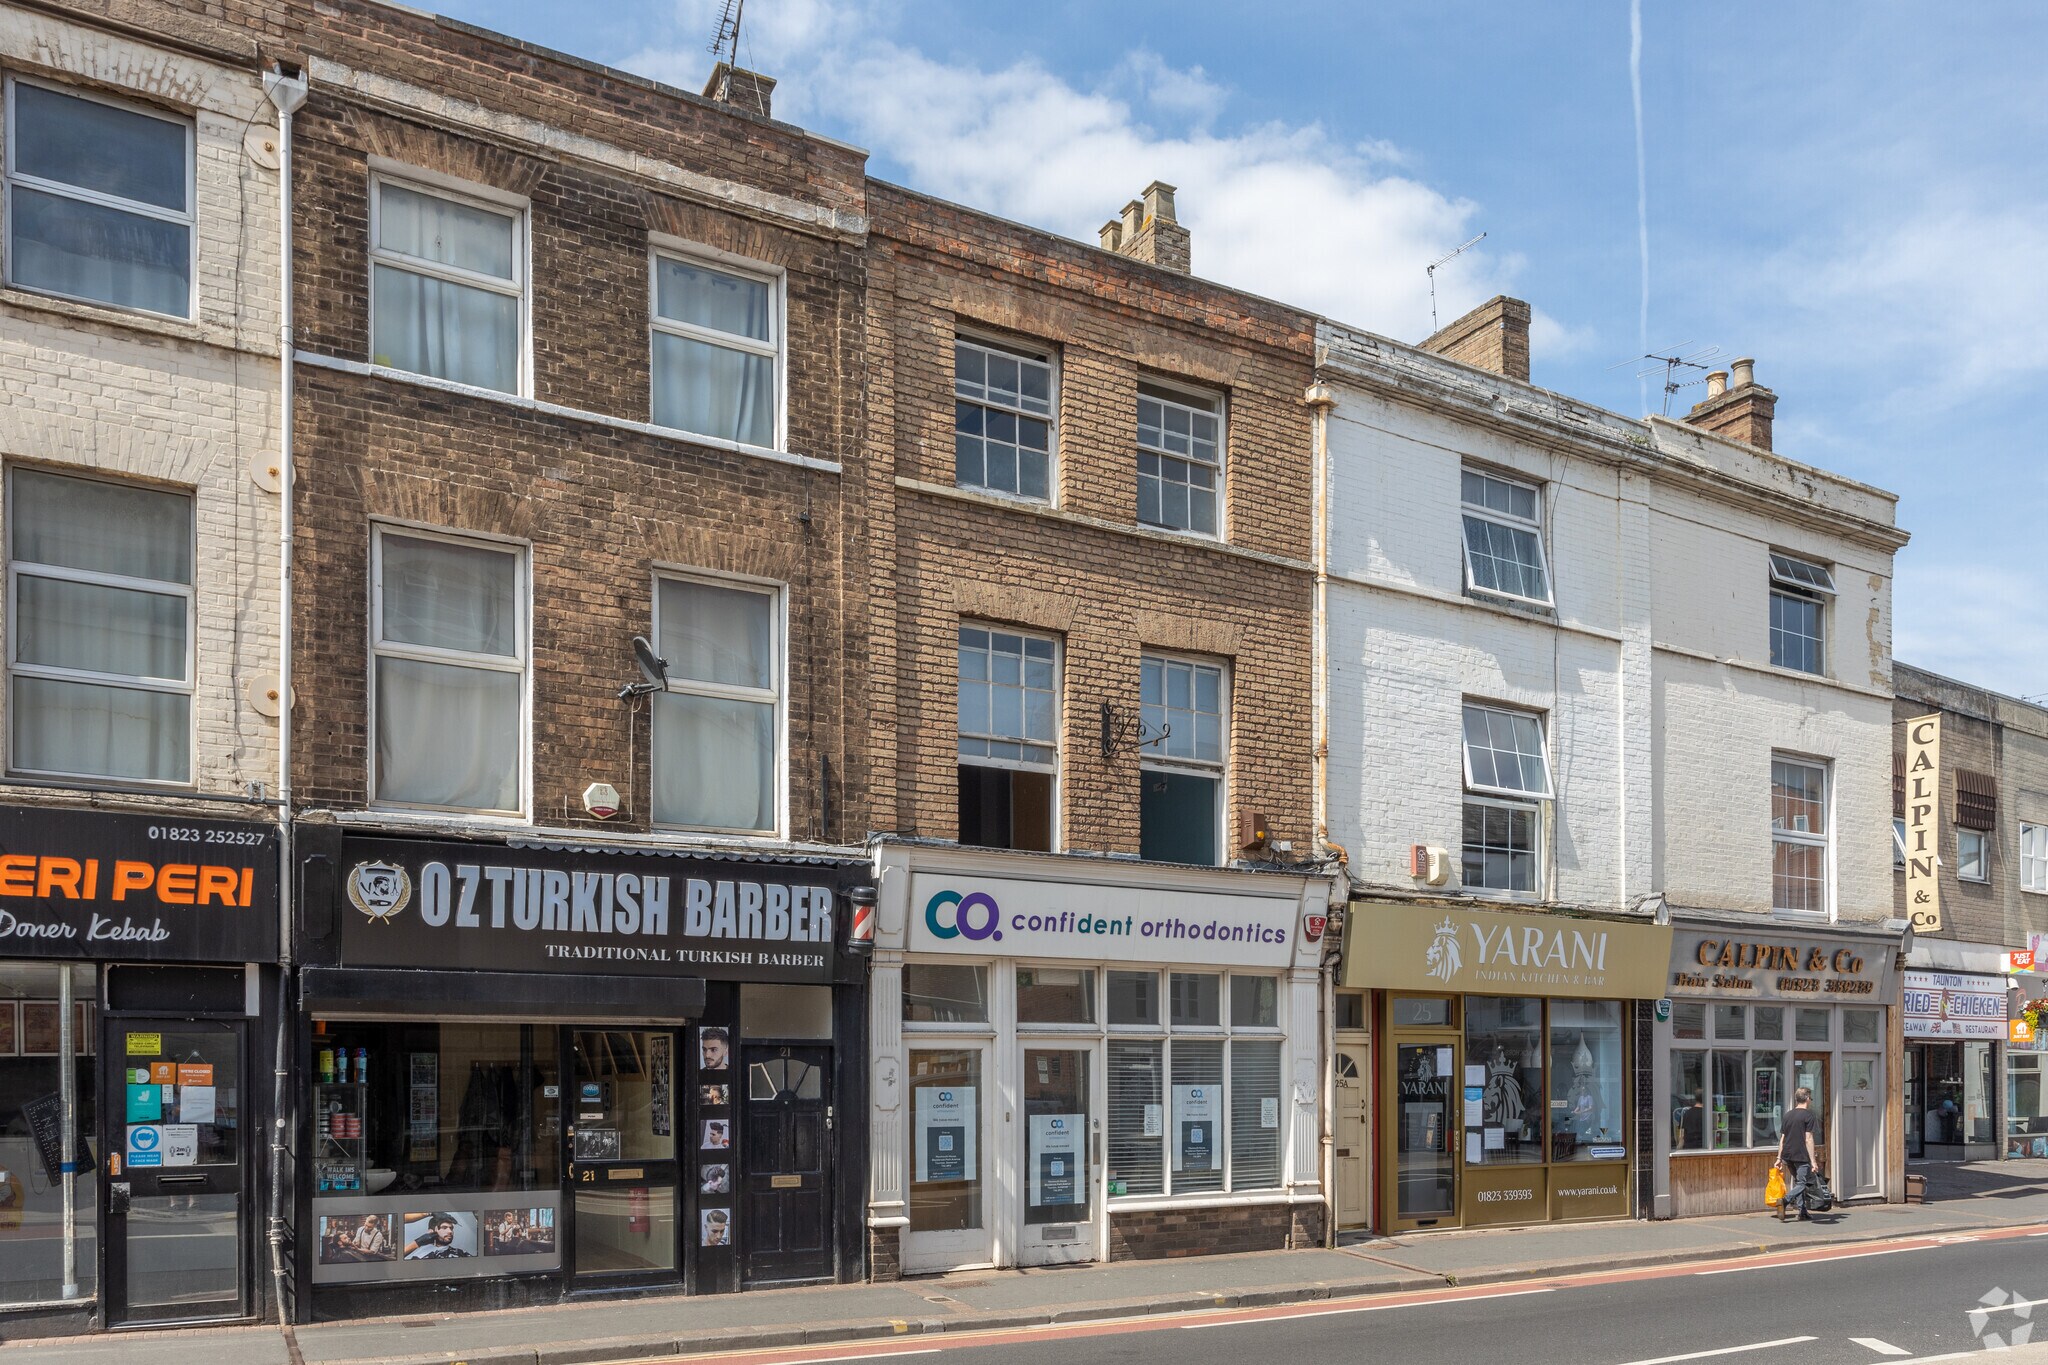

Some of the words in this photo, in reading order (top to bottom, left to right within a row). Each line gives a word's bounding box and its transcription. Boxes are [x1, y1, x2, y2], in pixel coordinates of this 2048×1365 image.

[1909, 722, 1934, 880] CALPIN
[149, 826, 200, 842] 01823
[205, 830, 264, 846] 252527
[112, 860, 254, 906] PERI
[1914, 890, 1930, 904] &
[684, 878, 832, 943] BARBER
[1911, 912, 1936, 926] Co
[0, 908, 76, 938] Doner
[86, 912, 170, 942] Kebab
[1012, 911, 1132, 936] confident
[1140, 917, 1286, 944] orthodontics
[1470, 922, 1607, 971] YARANI
[545, 944, 671, 962] TRADITIONAL
[676, 949, 752, 965] TURKISH
[758, 952, 824, 968] BARBER
[1698, 939, 1800, 971] CALPIN
[1807, 946, 1829, 972] &
[1834, 948, 1864, 974] Co
[1475, 970, 1516, 982] INDIAN
[1521, 972, 1569, 984] KITCHEN
[1573, 976, 1580, 984] &
[1584, 976, 1605, 986] BAR
[1674, 972, 1708, 988] Hair
[1712, 974, 1752, 990] Salon
[1933, 974, 1962, 986] TAUNTON
[1413, 1002, 1432, 1020] 25
[1954, 996, 2000, 1016] CHICKEN
[1966, 1026, 1998, 1034] RESTAURANT
[780, 1047, 790, 1056] 21
[1335, 1080, 1348, 1088] 25A
[1402, 1081, 1447, 1095] YARANI
[582, 1170, 595, 1181] 21
[1478, 1190, 1501, 1202] 01823
[1504, 1189, 1532, 1200] 339393
[1558, 1185, 1618, 1198] www.yarani.co.uk
